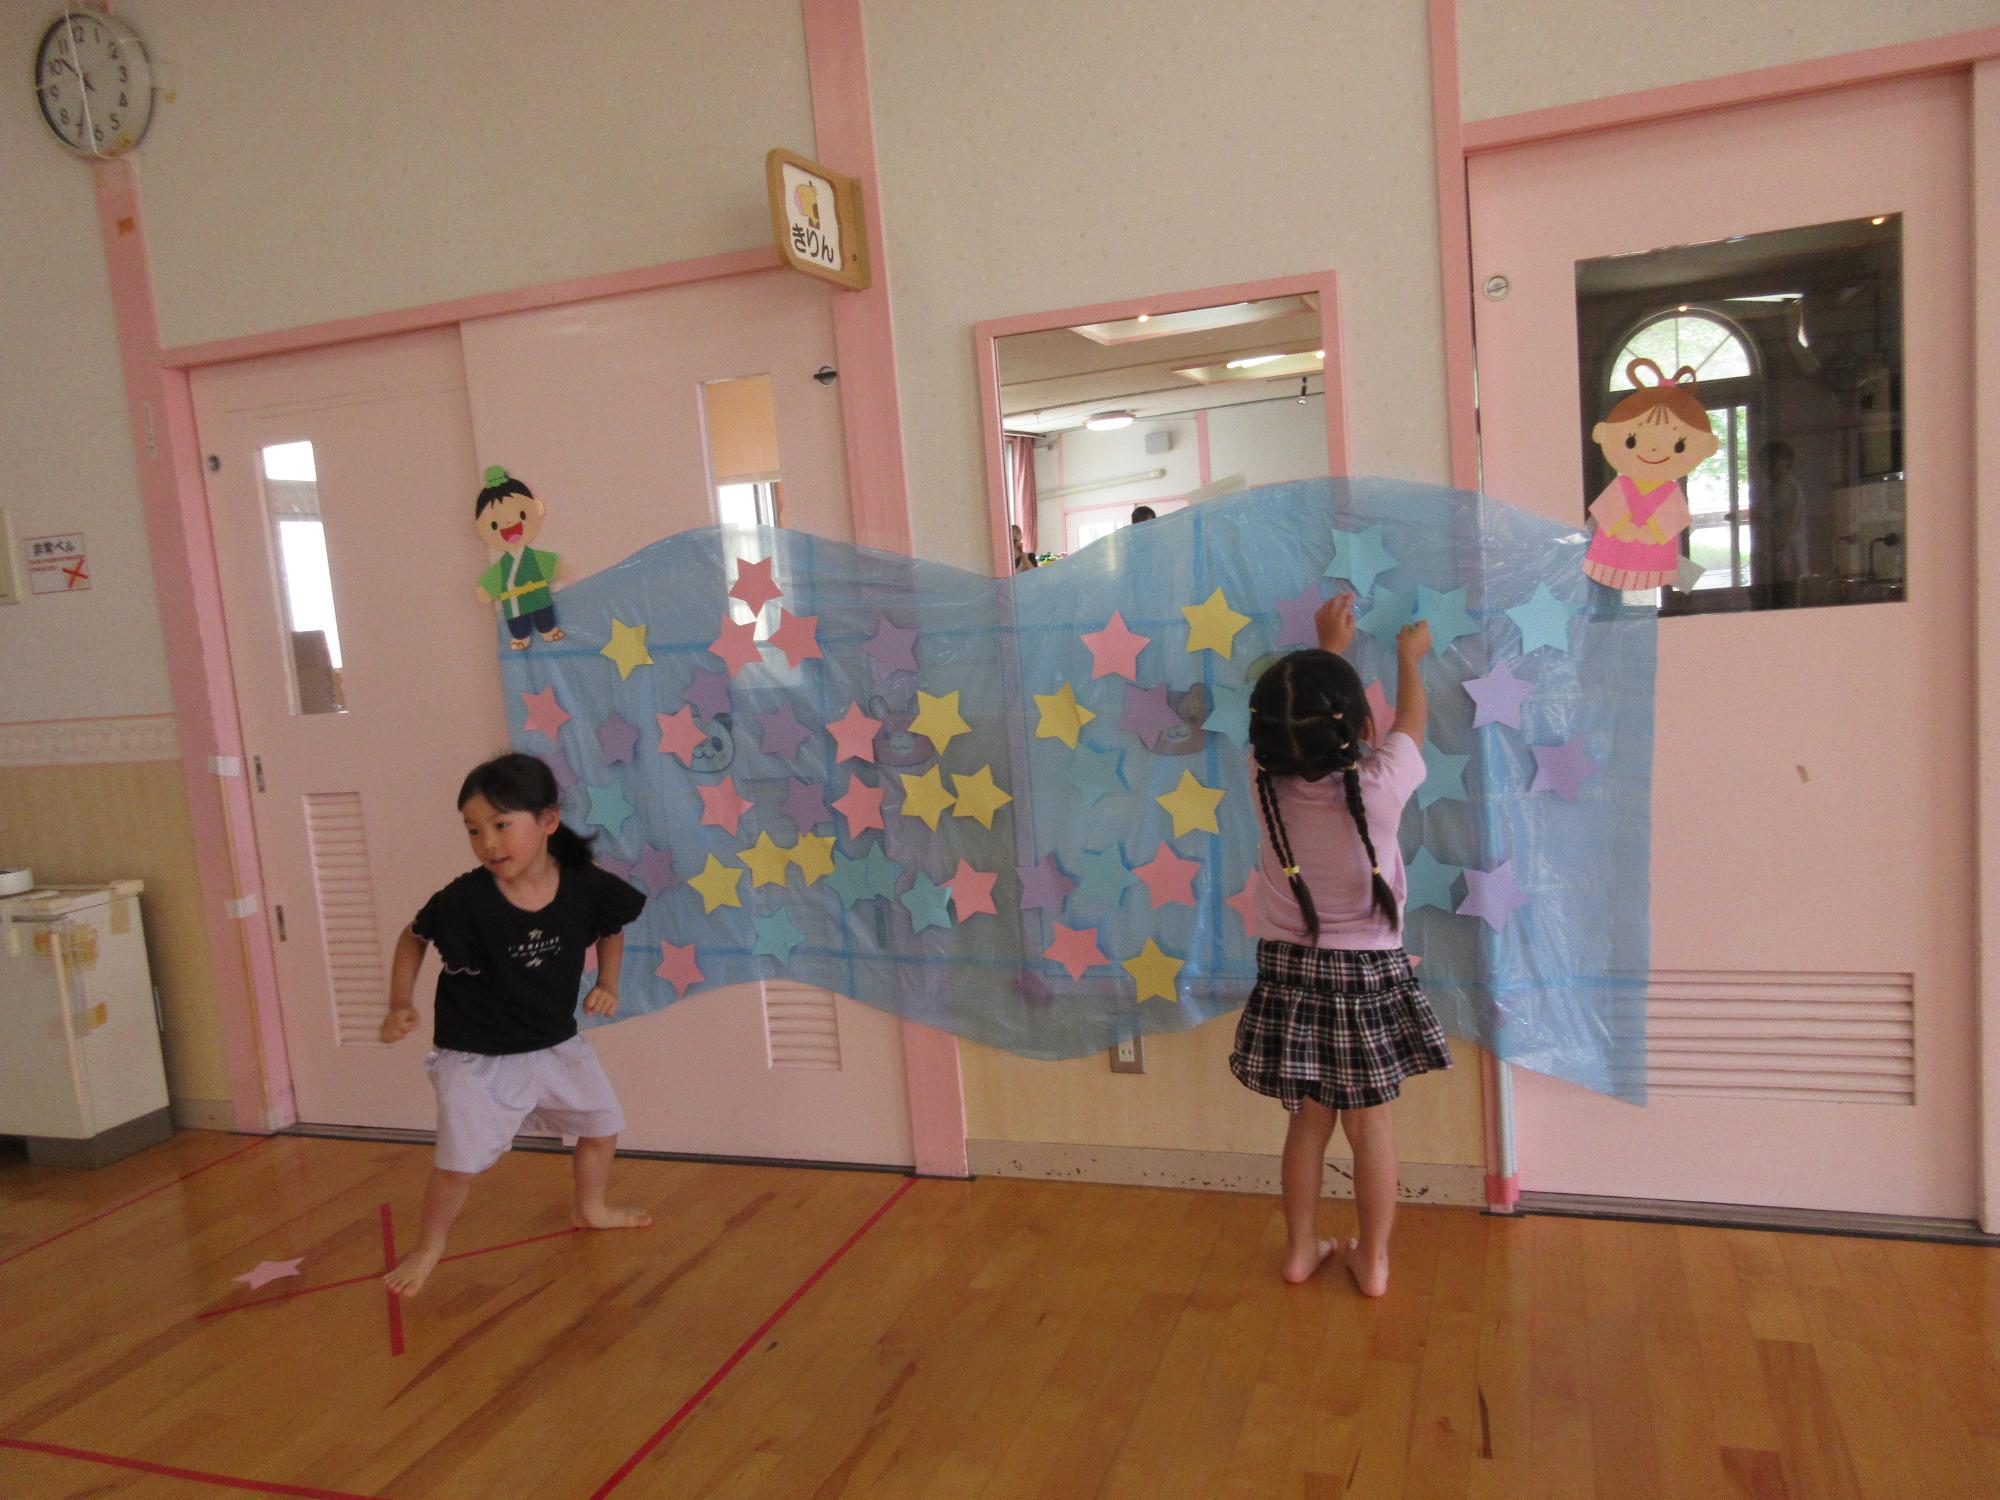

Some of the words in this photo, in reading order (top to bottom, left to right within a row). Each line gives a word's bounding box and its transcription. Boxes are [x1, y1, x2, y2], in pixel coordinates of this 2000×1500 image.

[73, 26, 86, 43] 12
[58, 38, 69, 54] 11
[108, 41, 120, 59] 2
[49, 58, 63, 75] 10
[119, 66, 128, 83] 3
[50, 85, 59, 101] 9
[119, 92, 128, 107] 4
[60, 107, 69, 125] 8
[110, 113, 119, 130] 5
[94, 123, 104, 141] 6
[792, 224, 834, 263] きりん
